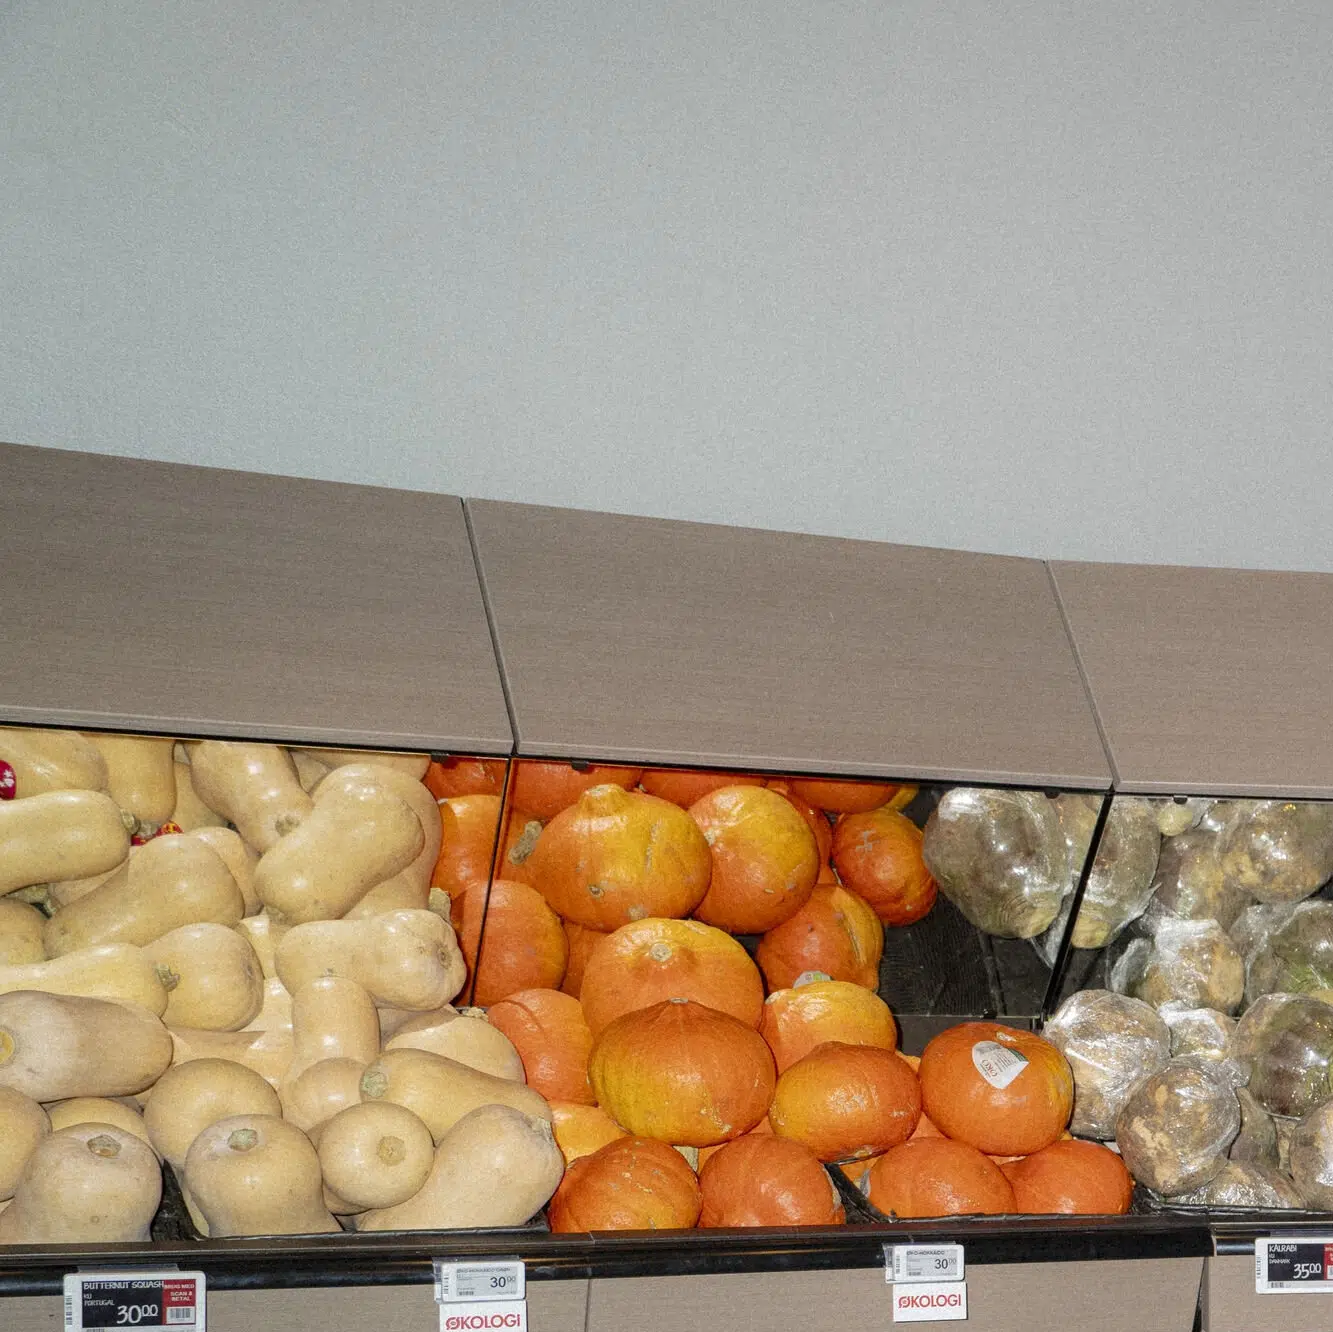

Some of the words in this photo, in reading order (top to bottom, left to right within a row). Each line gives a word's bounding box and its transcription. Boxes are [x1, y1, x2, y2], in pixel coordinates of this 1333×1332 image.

[84, 1281, 129, 1290] BUTTERNUT
[131, 1281, 164, 1289] SQUASH
[898, 1294, 962, 1309] ØKOLOGI
[446, 1314, 520, 1330] ØKOLOGI
